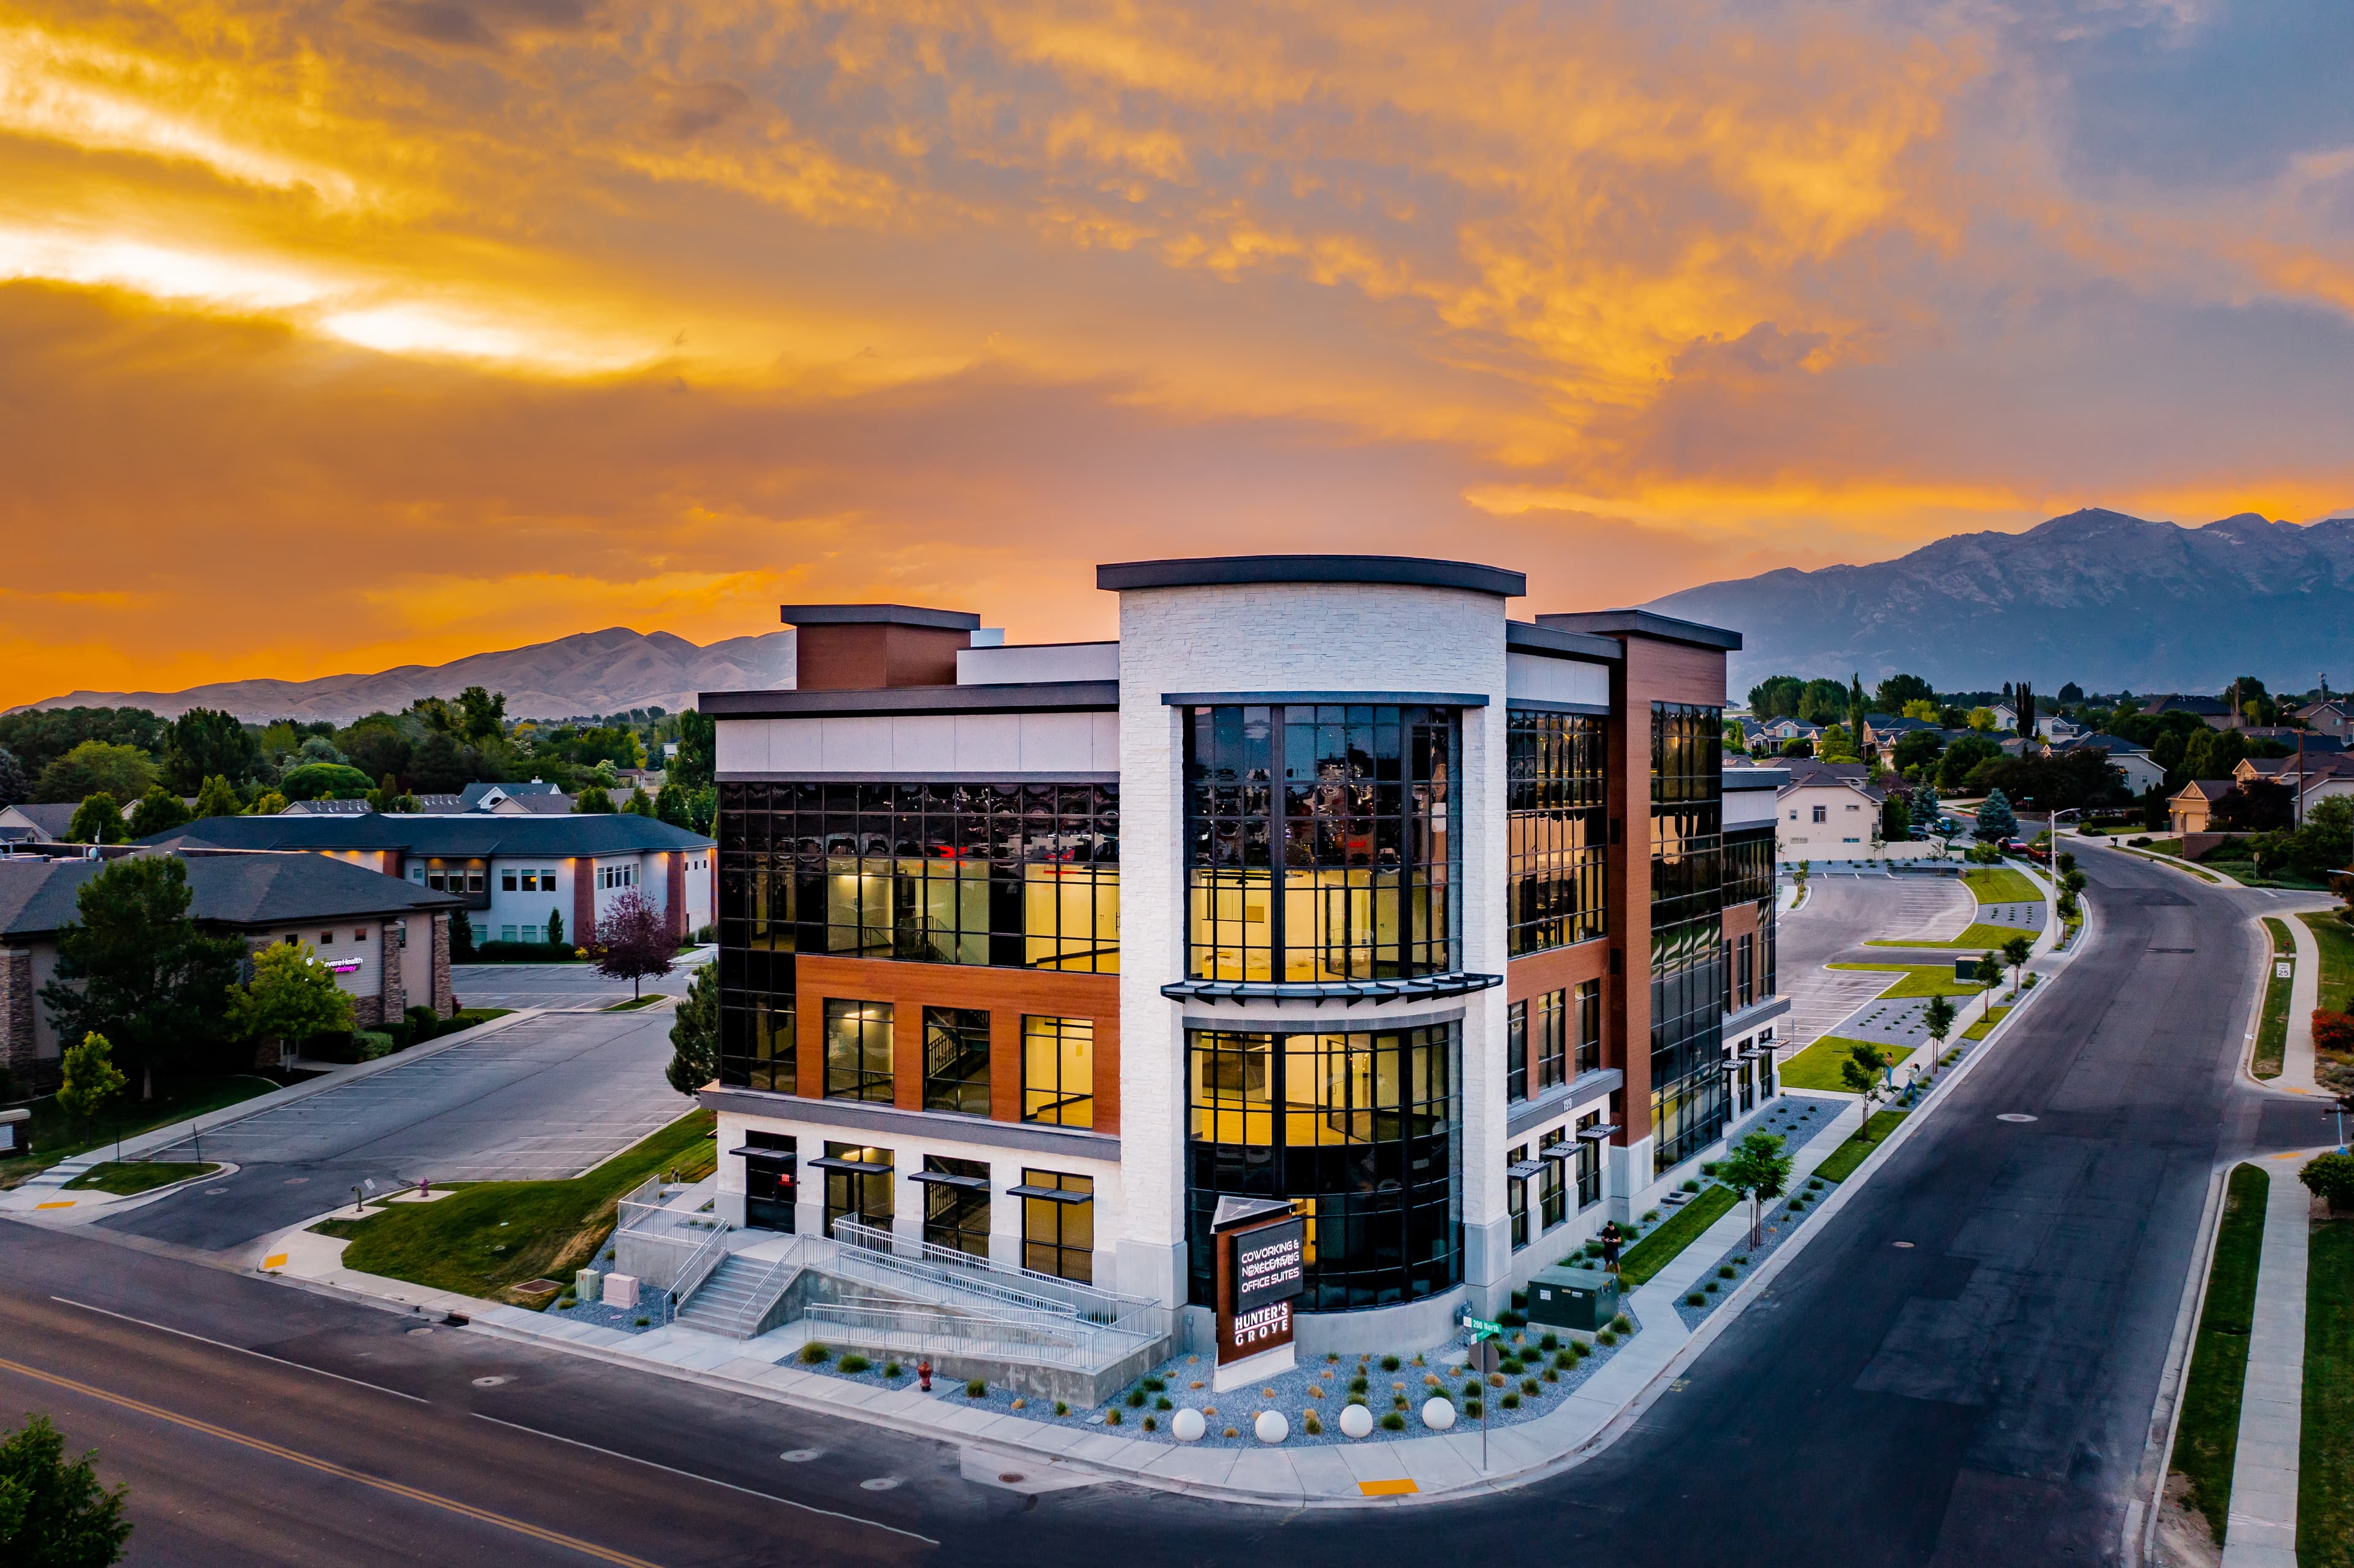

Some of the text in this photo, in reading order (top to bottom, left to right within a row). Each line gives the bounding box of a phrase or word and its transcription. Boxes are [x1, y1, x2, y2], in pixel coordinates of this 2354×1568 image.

[1241, 1239, 1299, 1264] COWORKING &
[1242, 1267, 1299, 1293] OFFICE SUITES
[1235, 1302, 1287, 1331] HUNTER'S
[1473, 1320, 1499, 1333] 200 North
[1235, 1319, 1288, 1347] GROVE
